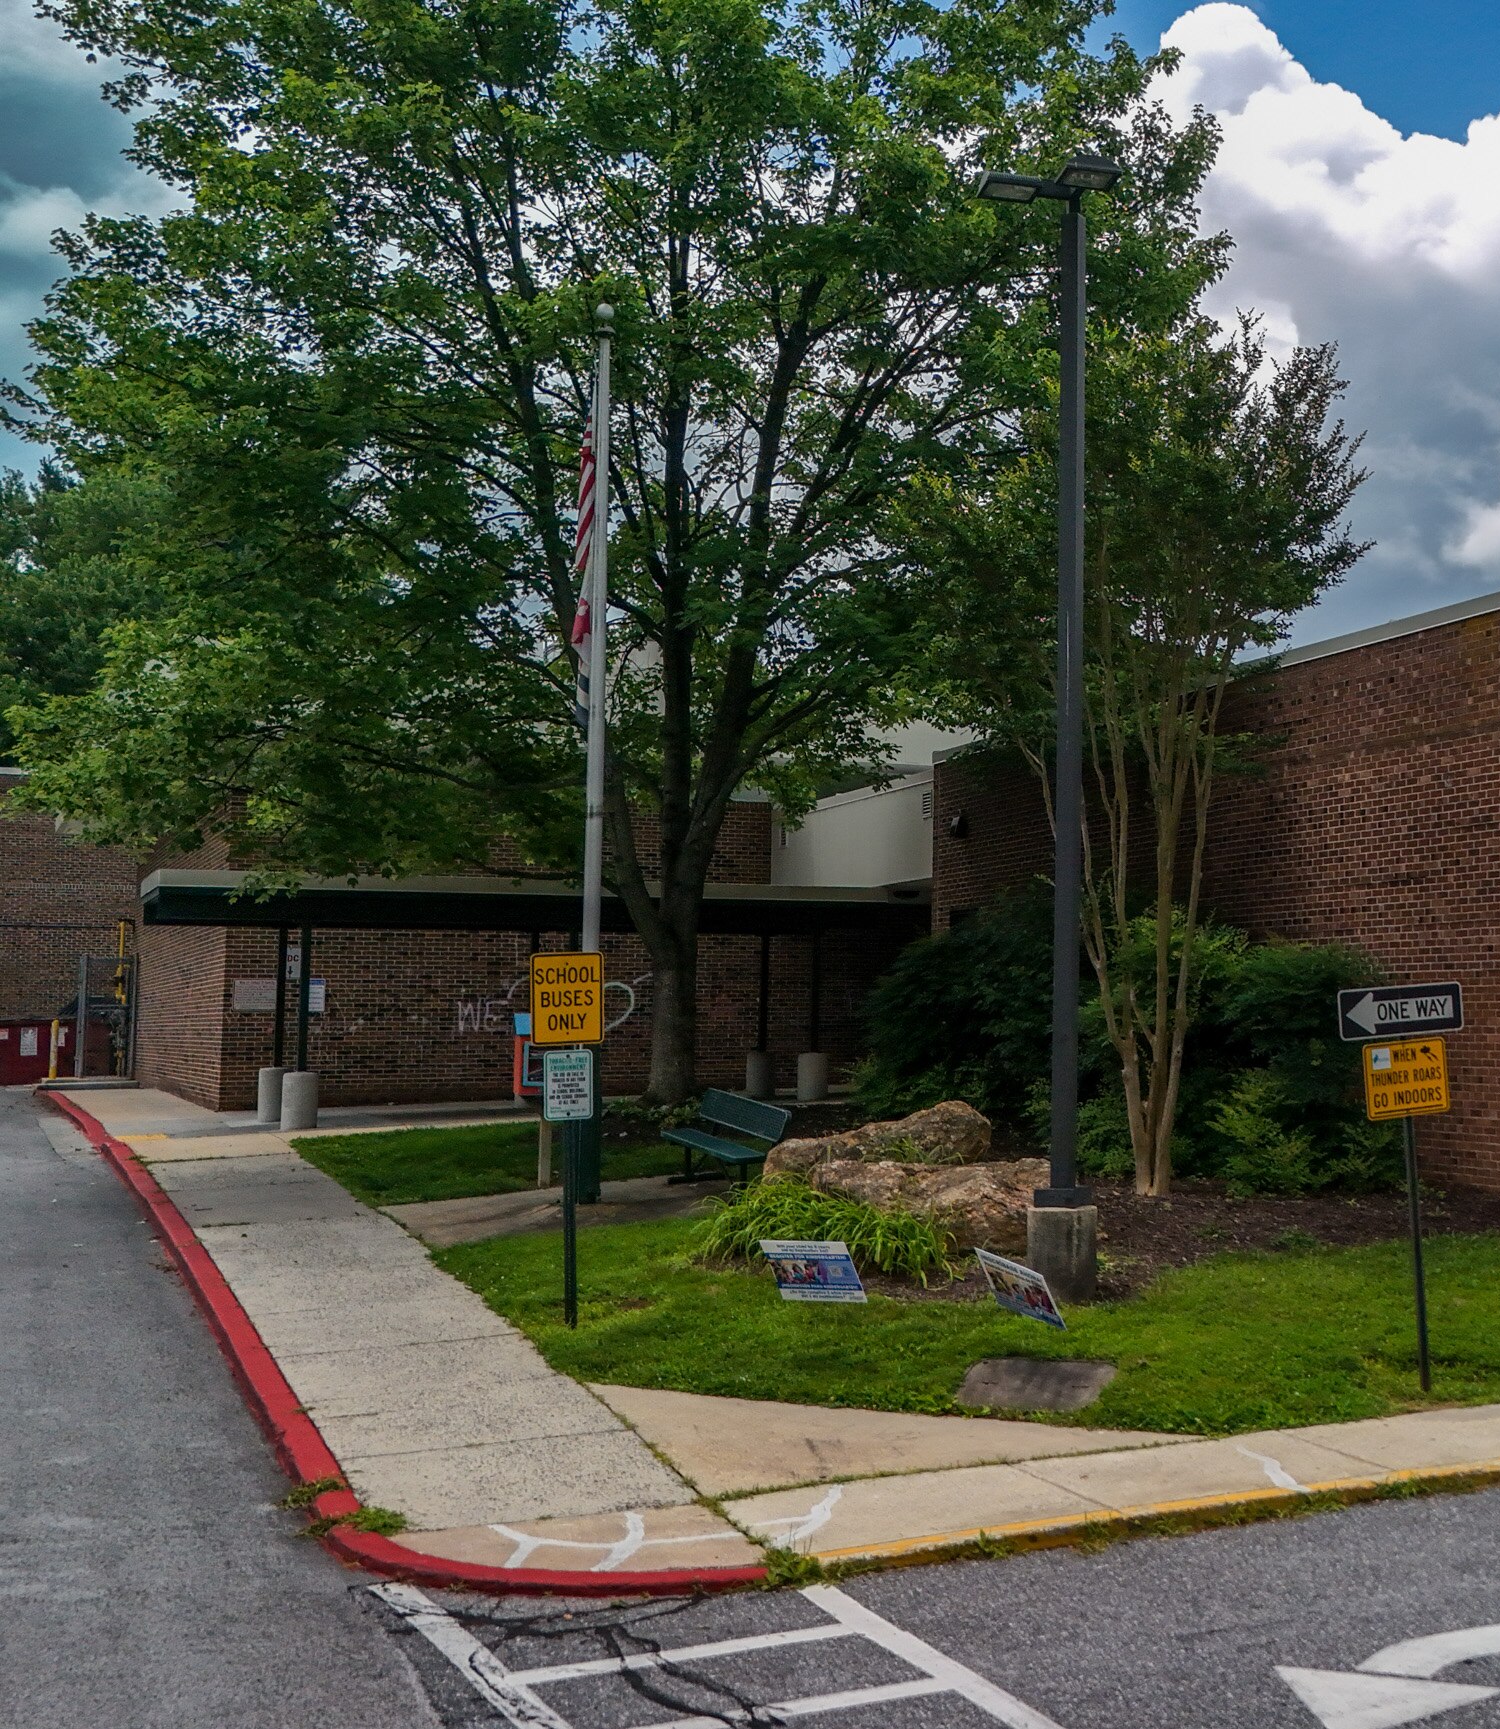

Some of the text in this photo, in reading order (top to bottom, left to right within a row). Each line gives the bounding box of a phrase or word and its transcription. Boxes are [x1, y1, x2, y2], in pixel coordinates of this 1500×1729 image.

[535, 966, 599, 984] SCHOOL
[541, 990, 593, 1008] BUSES
[1377, 998, 1448, 1021] ONE WAY
[548, 1013, 587, 1031] ONLY
[1392, 1047, 1417, 1063] WHEN
[1371, 1066, 1442, 1087] THUNDER ROARS
[1373, 1088, 1443, 1109] GO INDOORS
